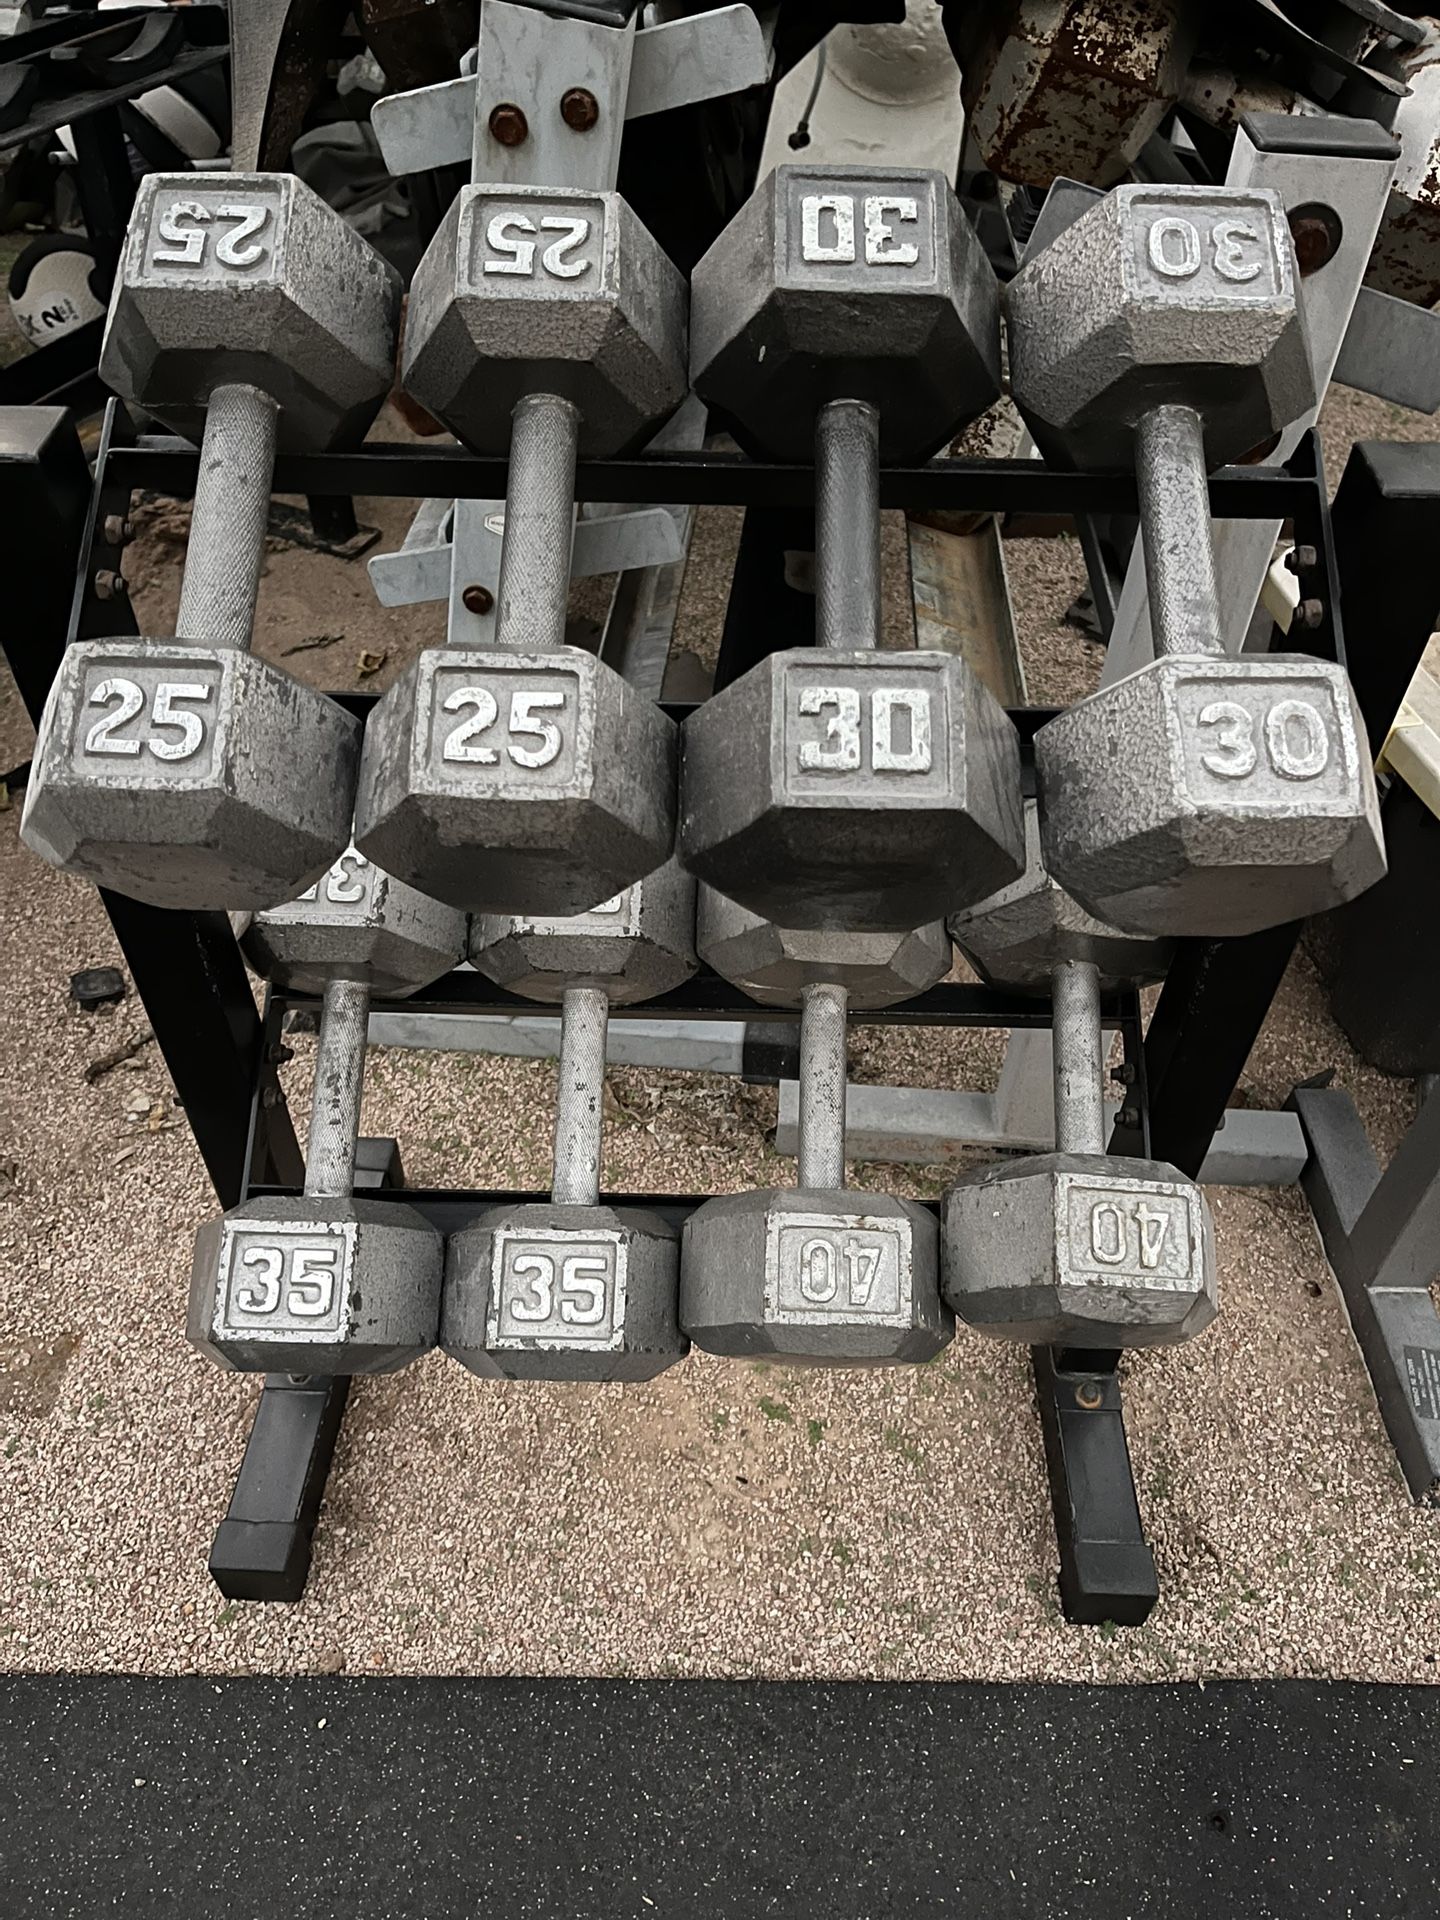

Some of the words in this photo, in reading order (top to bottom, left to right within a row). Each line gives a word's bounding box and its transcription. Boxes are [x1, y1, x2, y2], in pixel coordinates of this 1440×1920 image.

[152, 201, 268, 266] 25
[484, 212, 590, 278] 25
[802, 195, 919, 266] 30
[1148, 217, 1262, 281] 30
[85, 678, 211, 760] 25
[443, 687, 565, 768] 25
[799, 687, 932, 773] 30
[1199, 700, 1329, 779] 30
[1091, 1202, 1169, 1270] 40
[237, 1246, 337, 1315] 35
[510, 1254, 607, 1325] 35
[800, 1238, 883, 1306] 40
